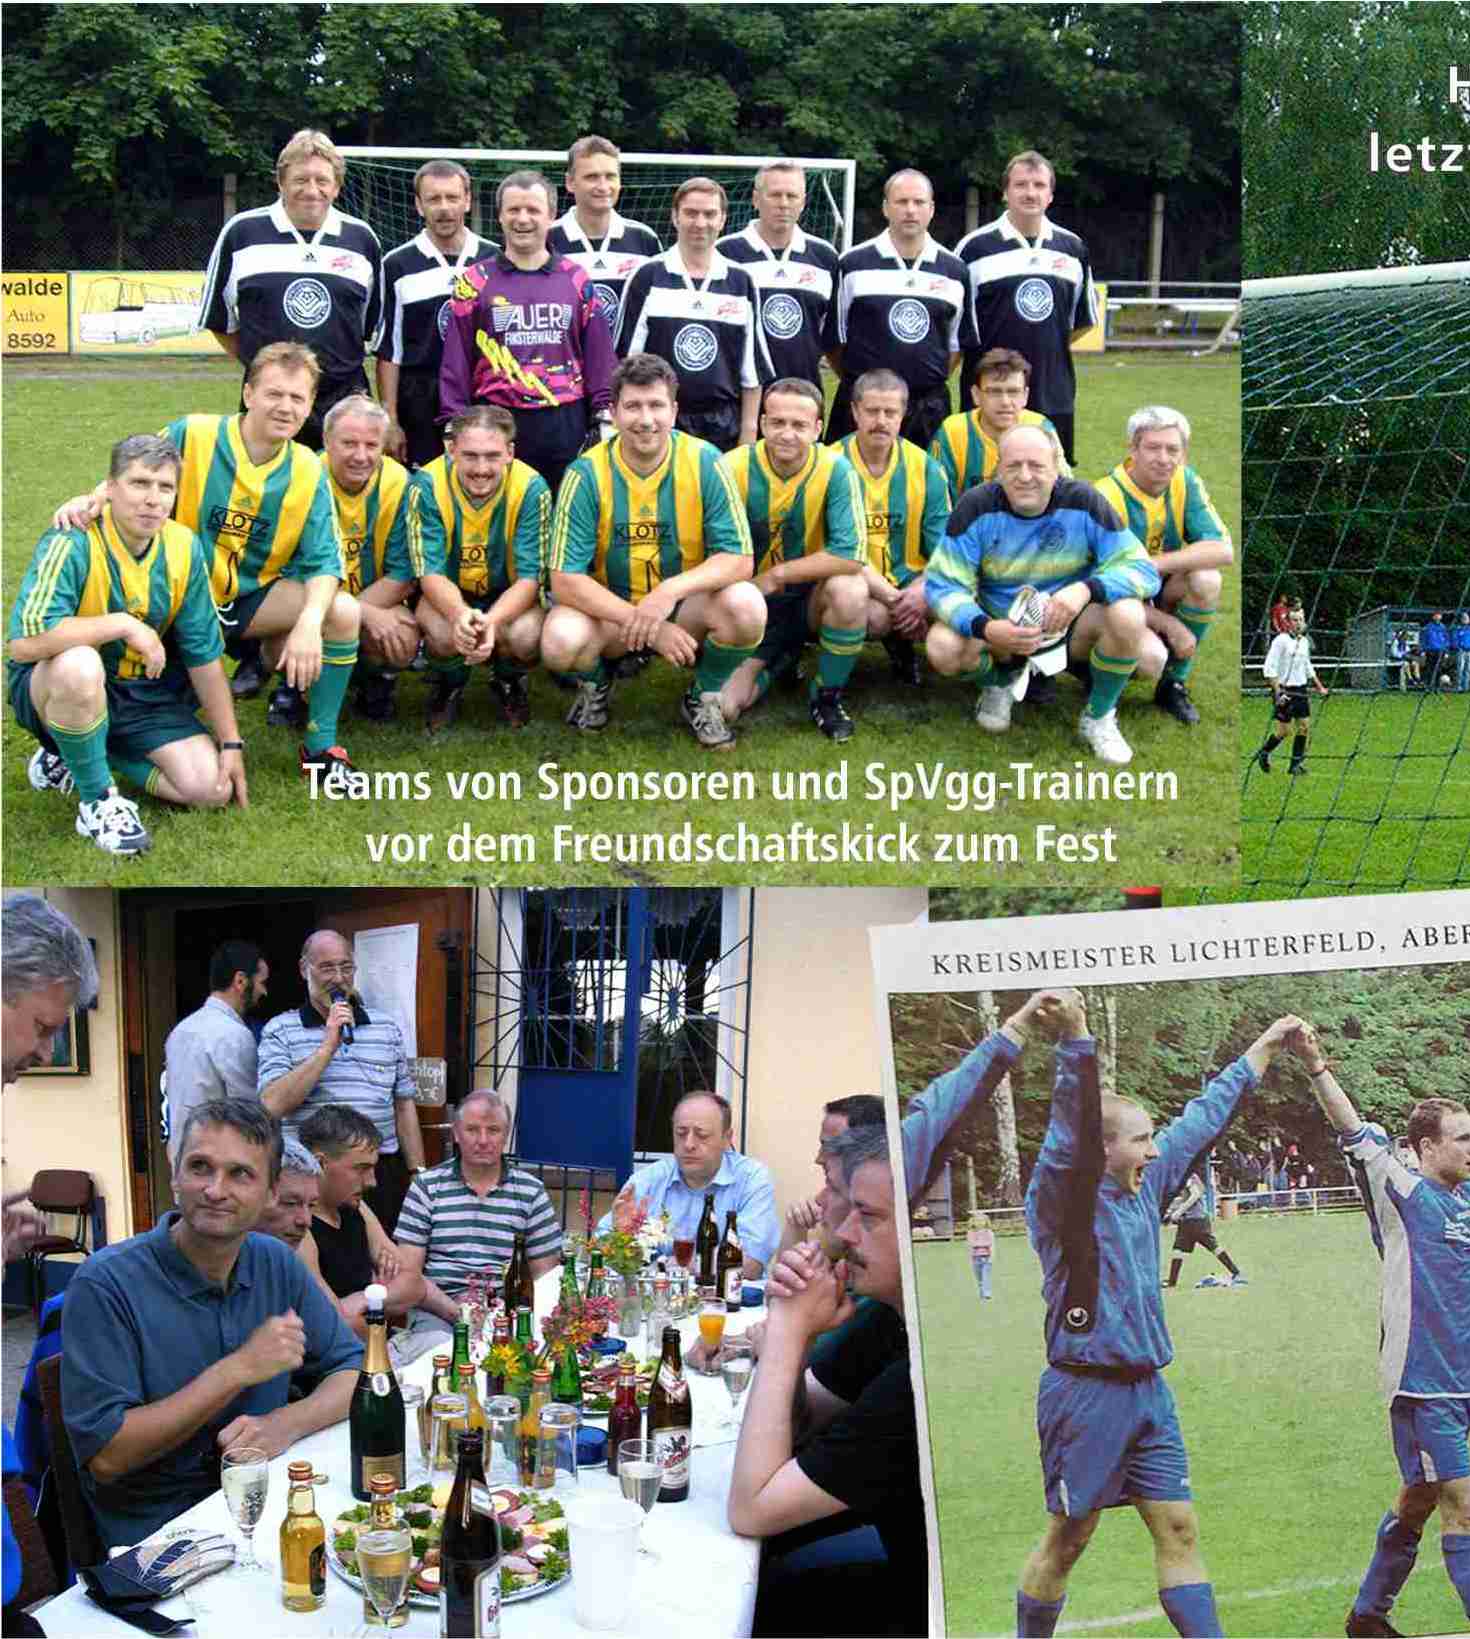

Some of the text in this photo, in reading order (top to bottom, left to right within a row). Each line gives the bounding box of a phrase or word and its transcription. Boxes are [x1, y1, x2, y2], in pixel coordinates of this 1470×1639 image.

[505, 303, 562, 330] AUER
[8, 333, 56, 348] 8592
[210, 508, 270, 540] KLOTZ
[614, 523, 673, 539] KLOTZ
[931, 944, 1158, 976] KREISMEISTER
[1170, 930, 1387, 964] LICHTERFELD,
